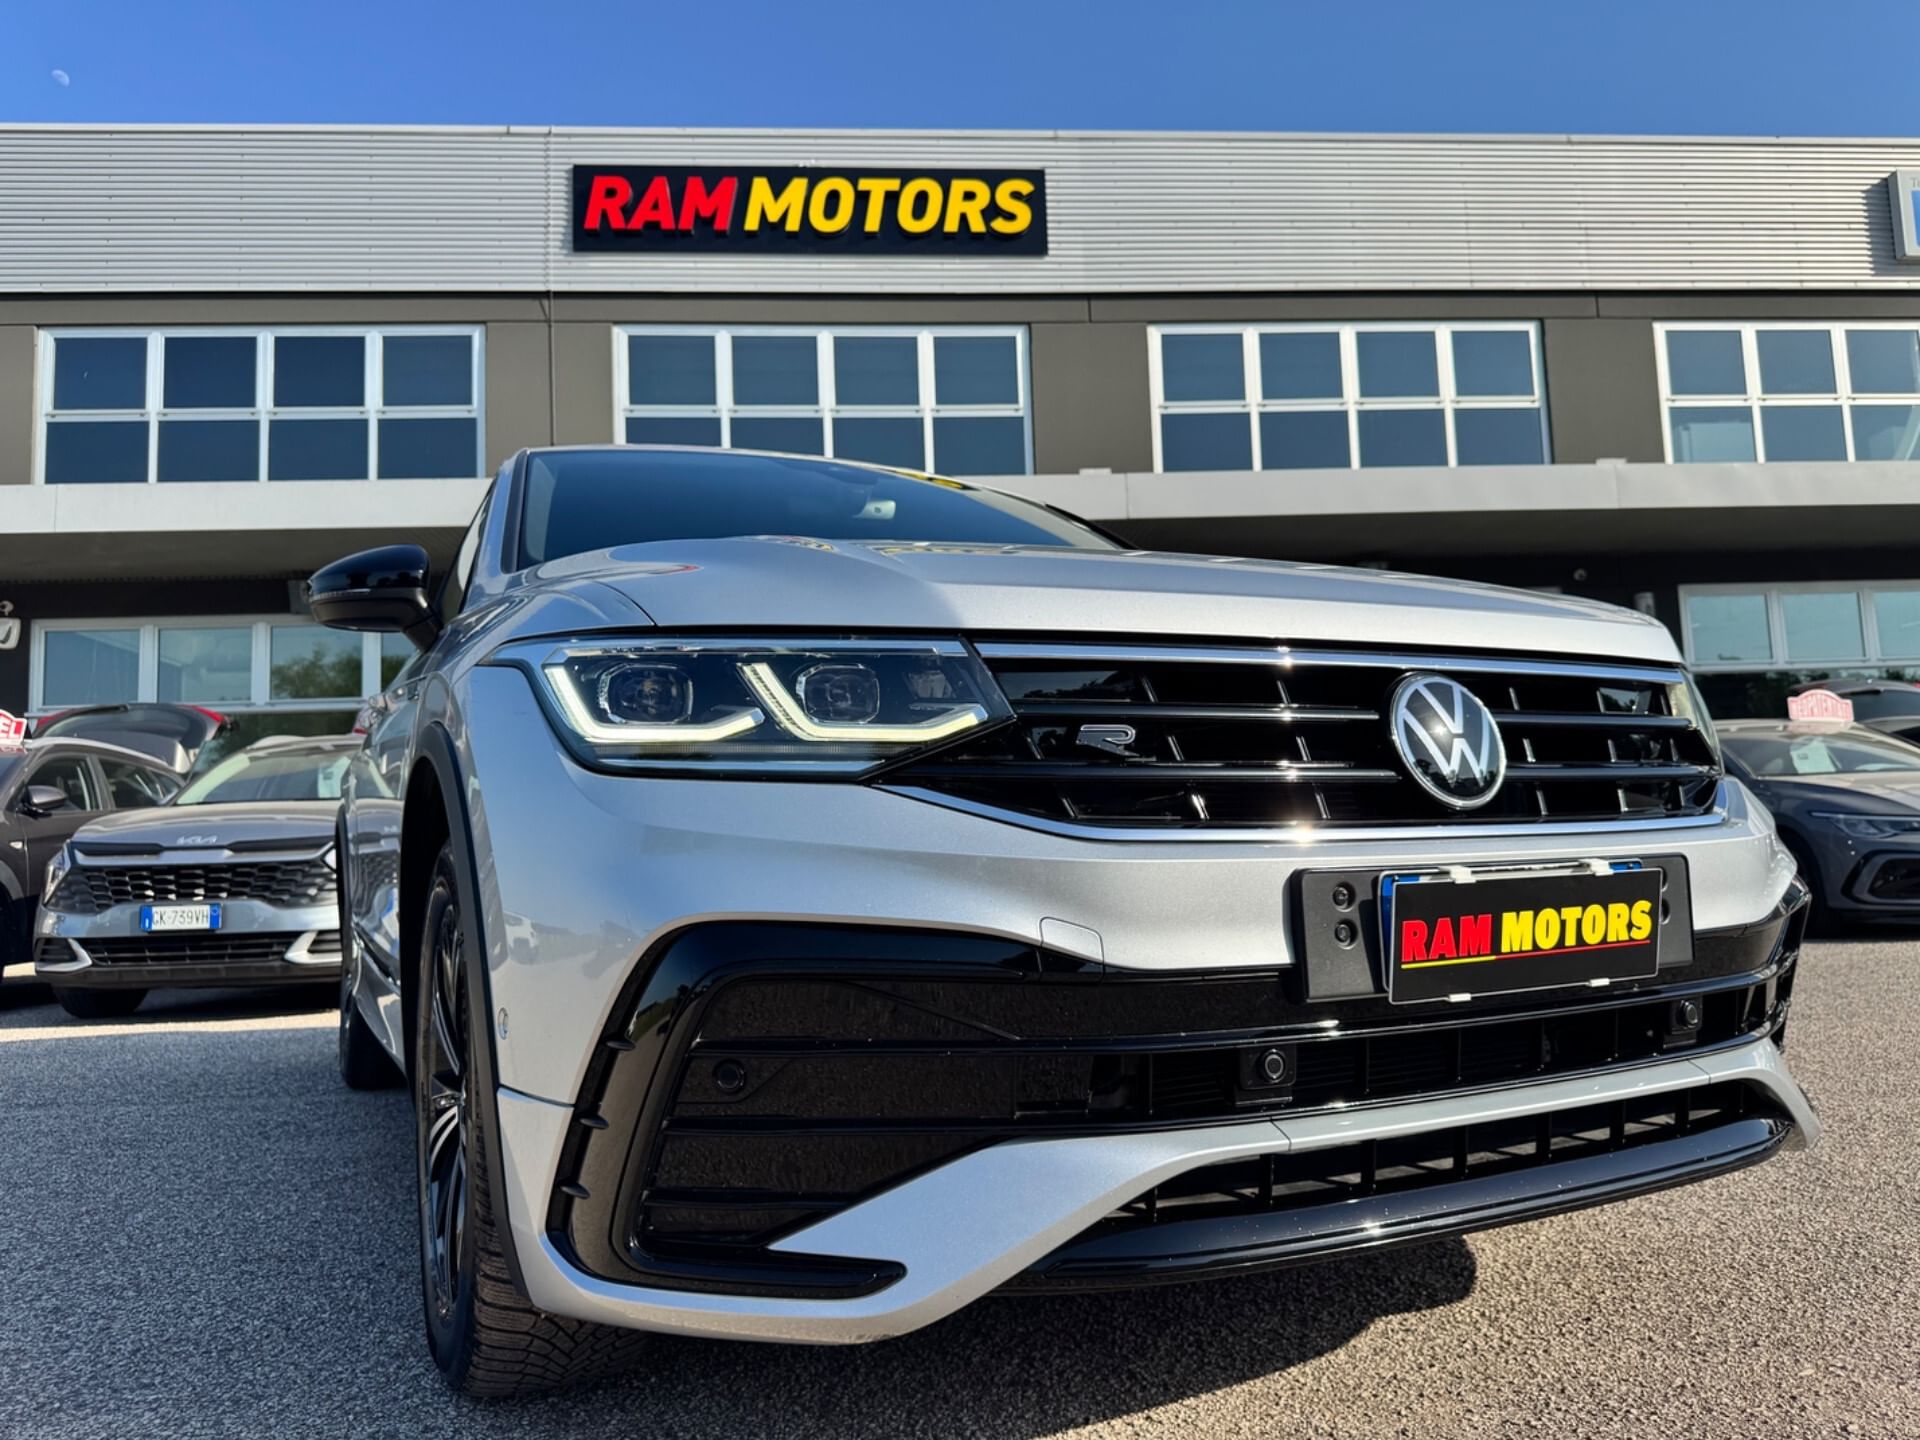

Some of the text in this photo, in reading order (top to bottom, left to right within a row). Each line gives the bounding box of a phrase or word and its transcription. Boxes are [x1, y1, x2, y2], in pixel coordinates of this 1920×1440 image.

[583, 175, 1036, 235] RAM MOTORS
[1401, 899, 1653, 963] RAM MOTORS
